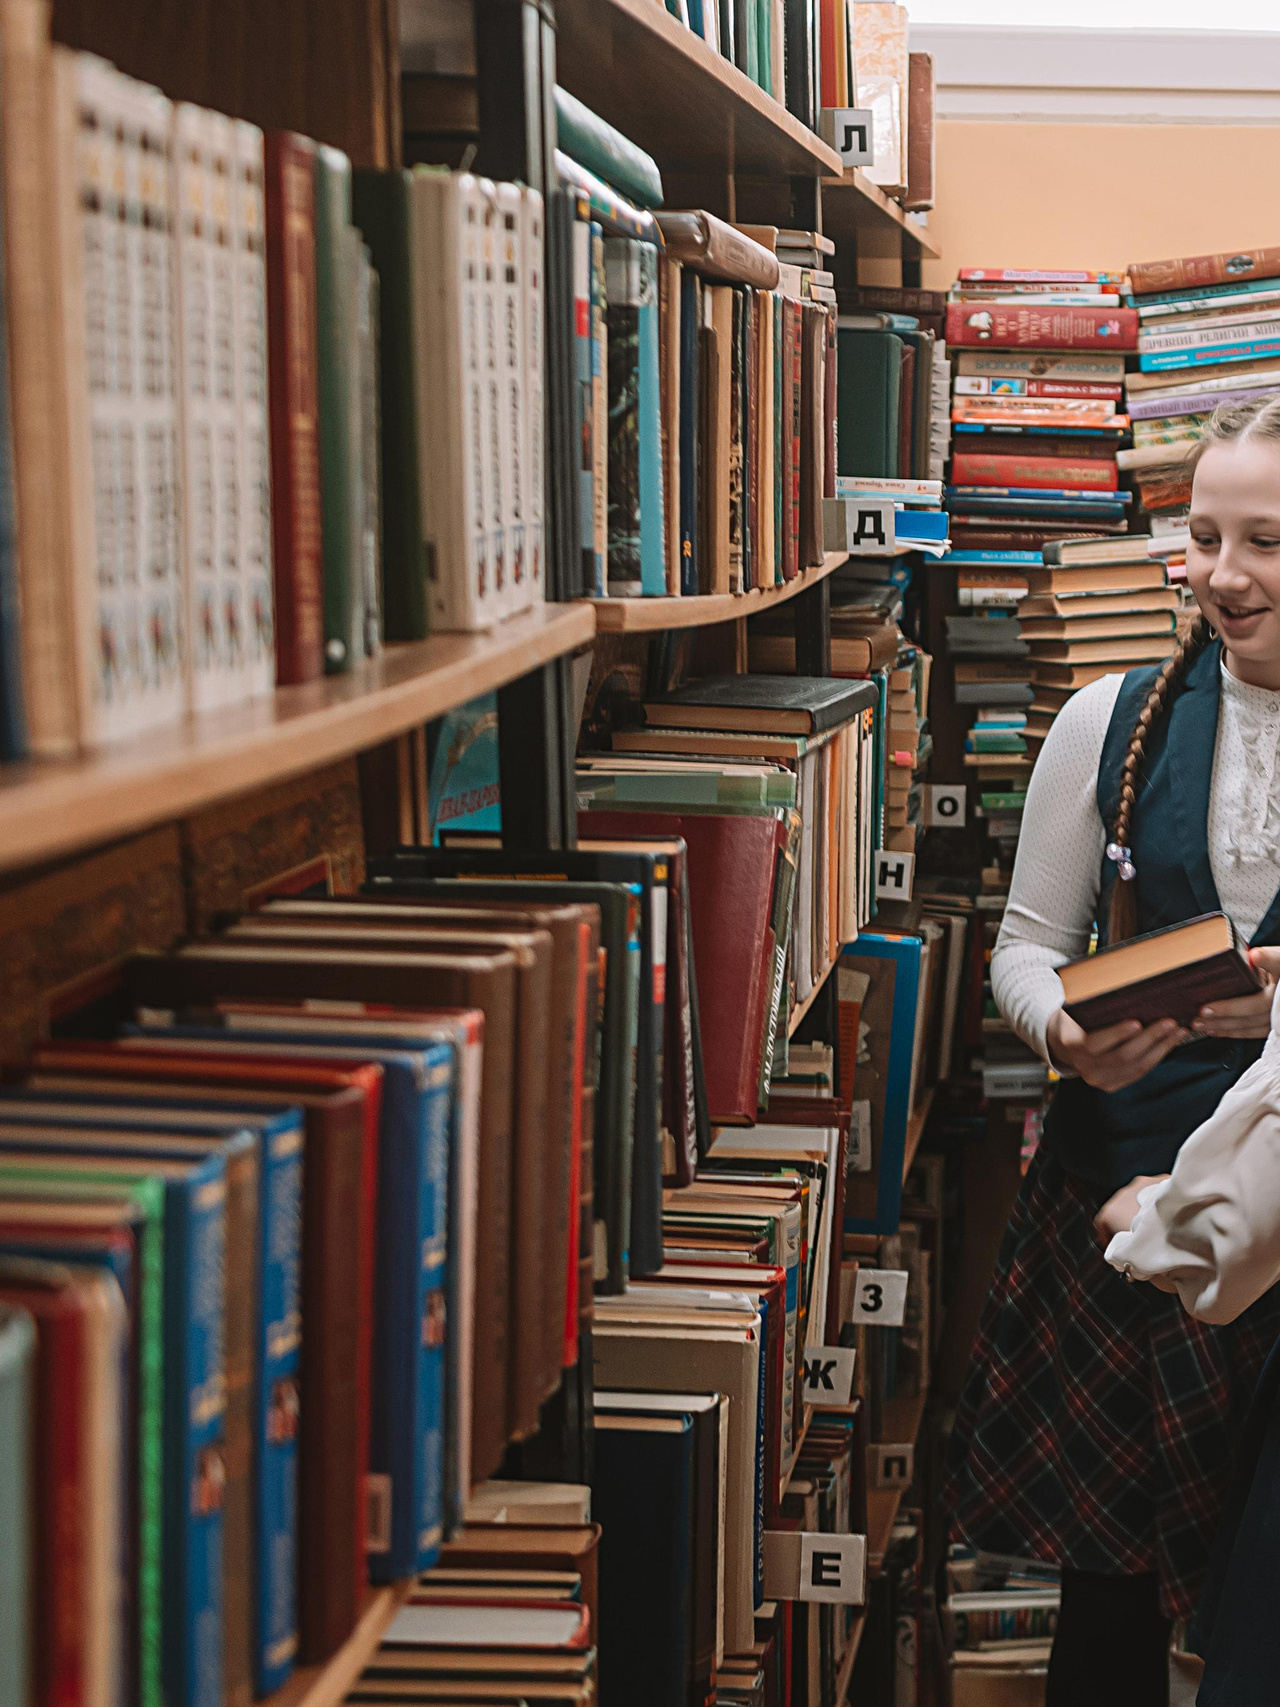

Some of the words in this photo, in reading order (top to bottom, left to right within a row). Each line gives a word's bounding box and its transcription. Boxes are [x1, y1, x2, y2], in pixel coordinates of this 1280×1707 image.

[840, 125, 867, 152] Л
[1145, 332, 1194, 350] ДРЕВНИЕ
[1200, 328, 1250, 344] РЕЛИГИИ
[853, 510, 885, 545] Д
[937, 794, 959, 816] О
[879, 860, 905, 888] Н
[884, 1454, 906, 1479] П
[811, 1551, 842, 1588] Е
